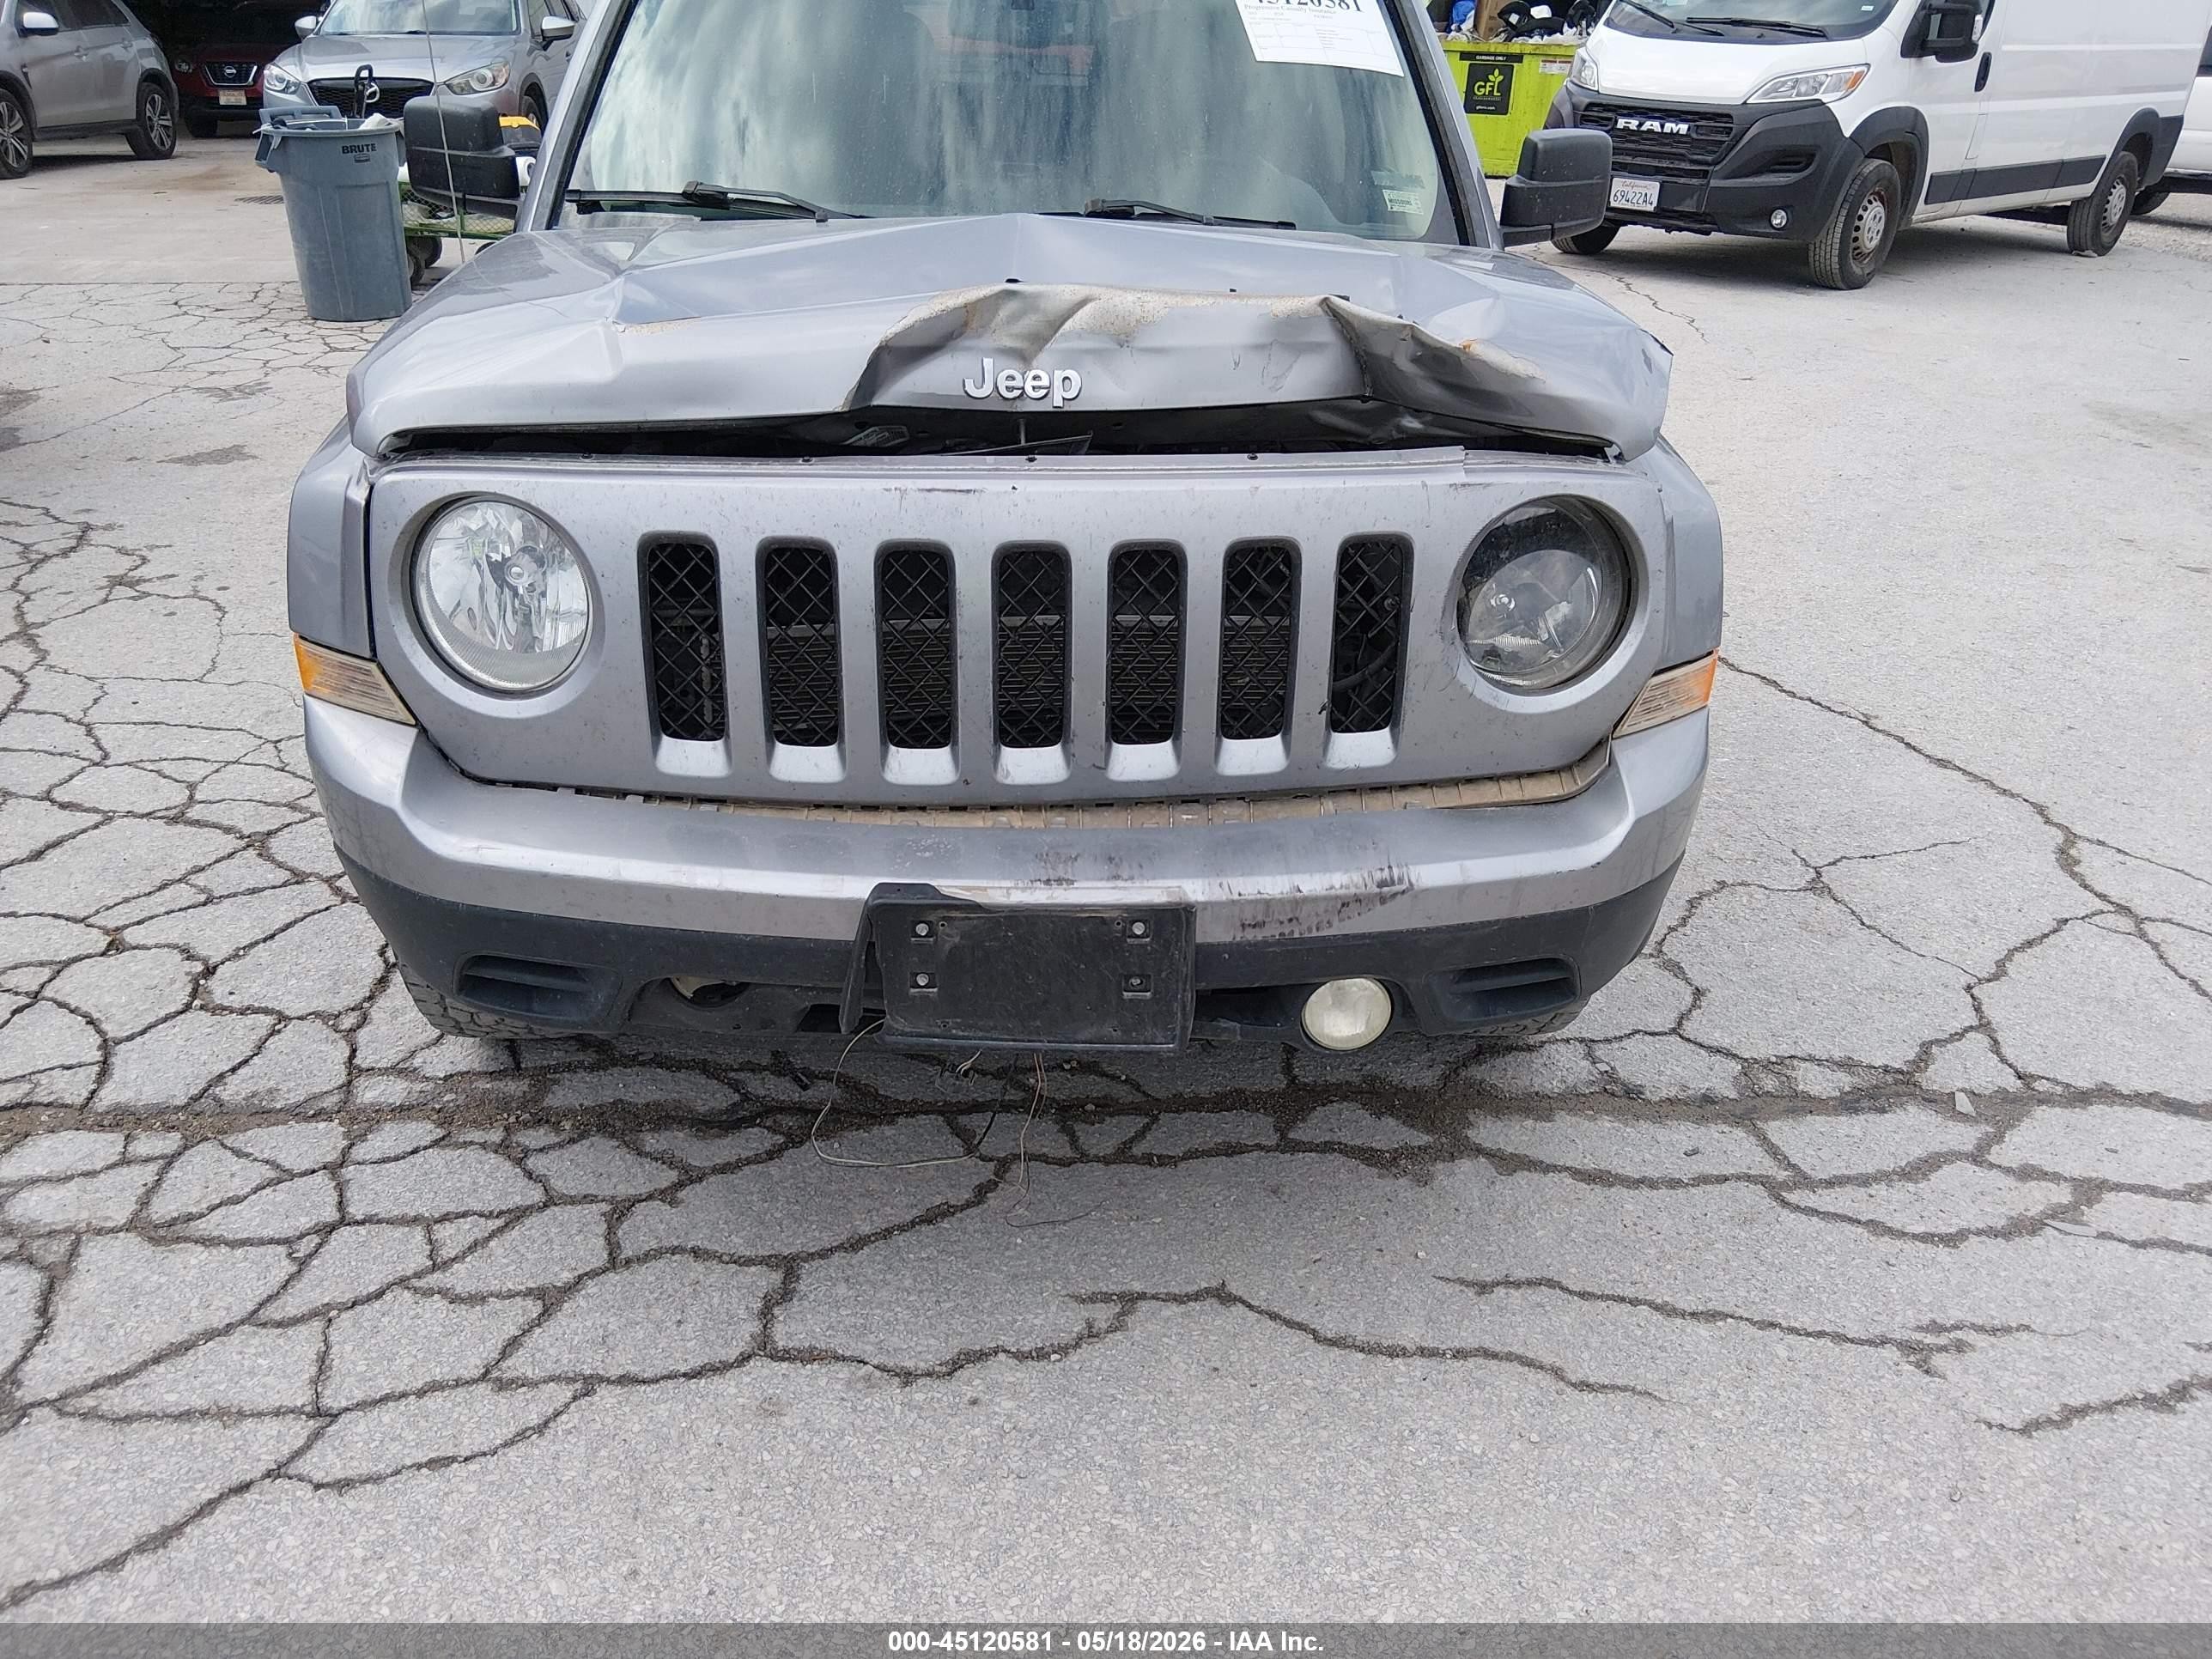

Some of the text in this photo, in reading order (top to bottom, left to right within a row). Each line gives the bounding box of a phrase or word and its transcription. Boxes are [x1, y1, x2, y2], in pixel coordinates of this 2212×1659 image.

[1474, 77, 1502, 96] GFL
[1616, 118, 1689, 135] RAM
[342, 143, 377, 155] BRUTE
[1613, 188, 1654, 206] 69422A4
[963, 357, 1082, 409] Jeep
